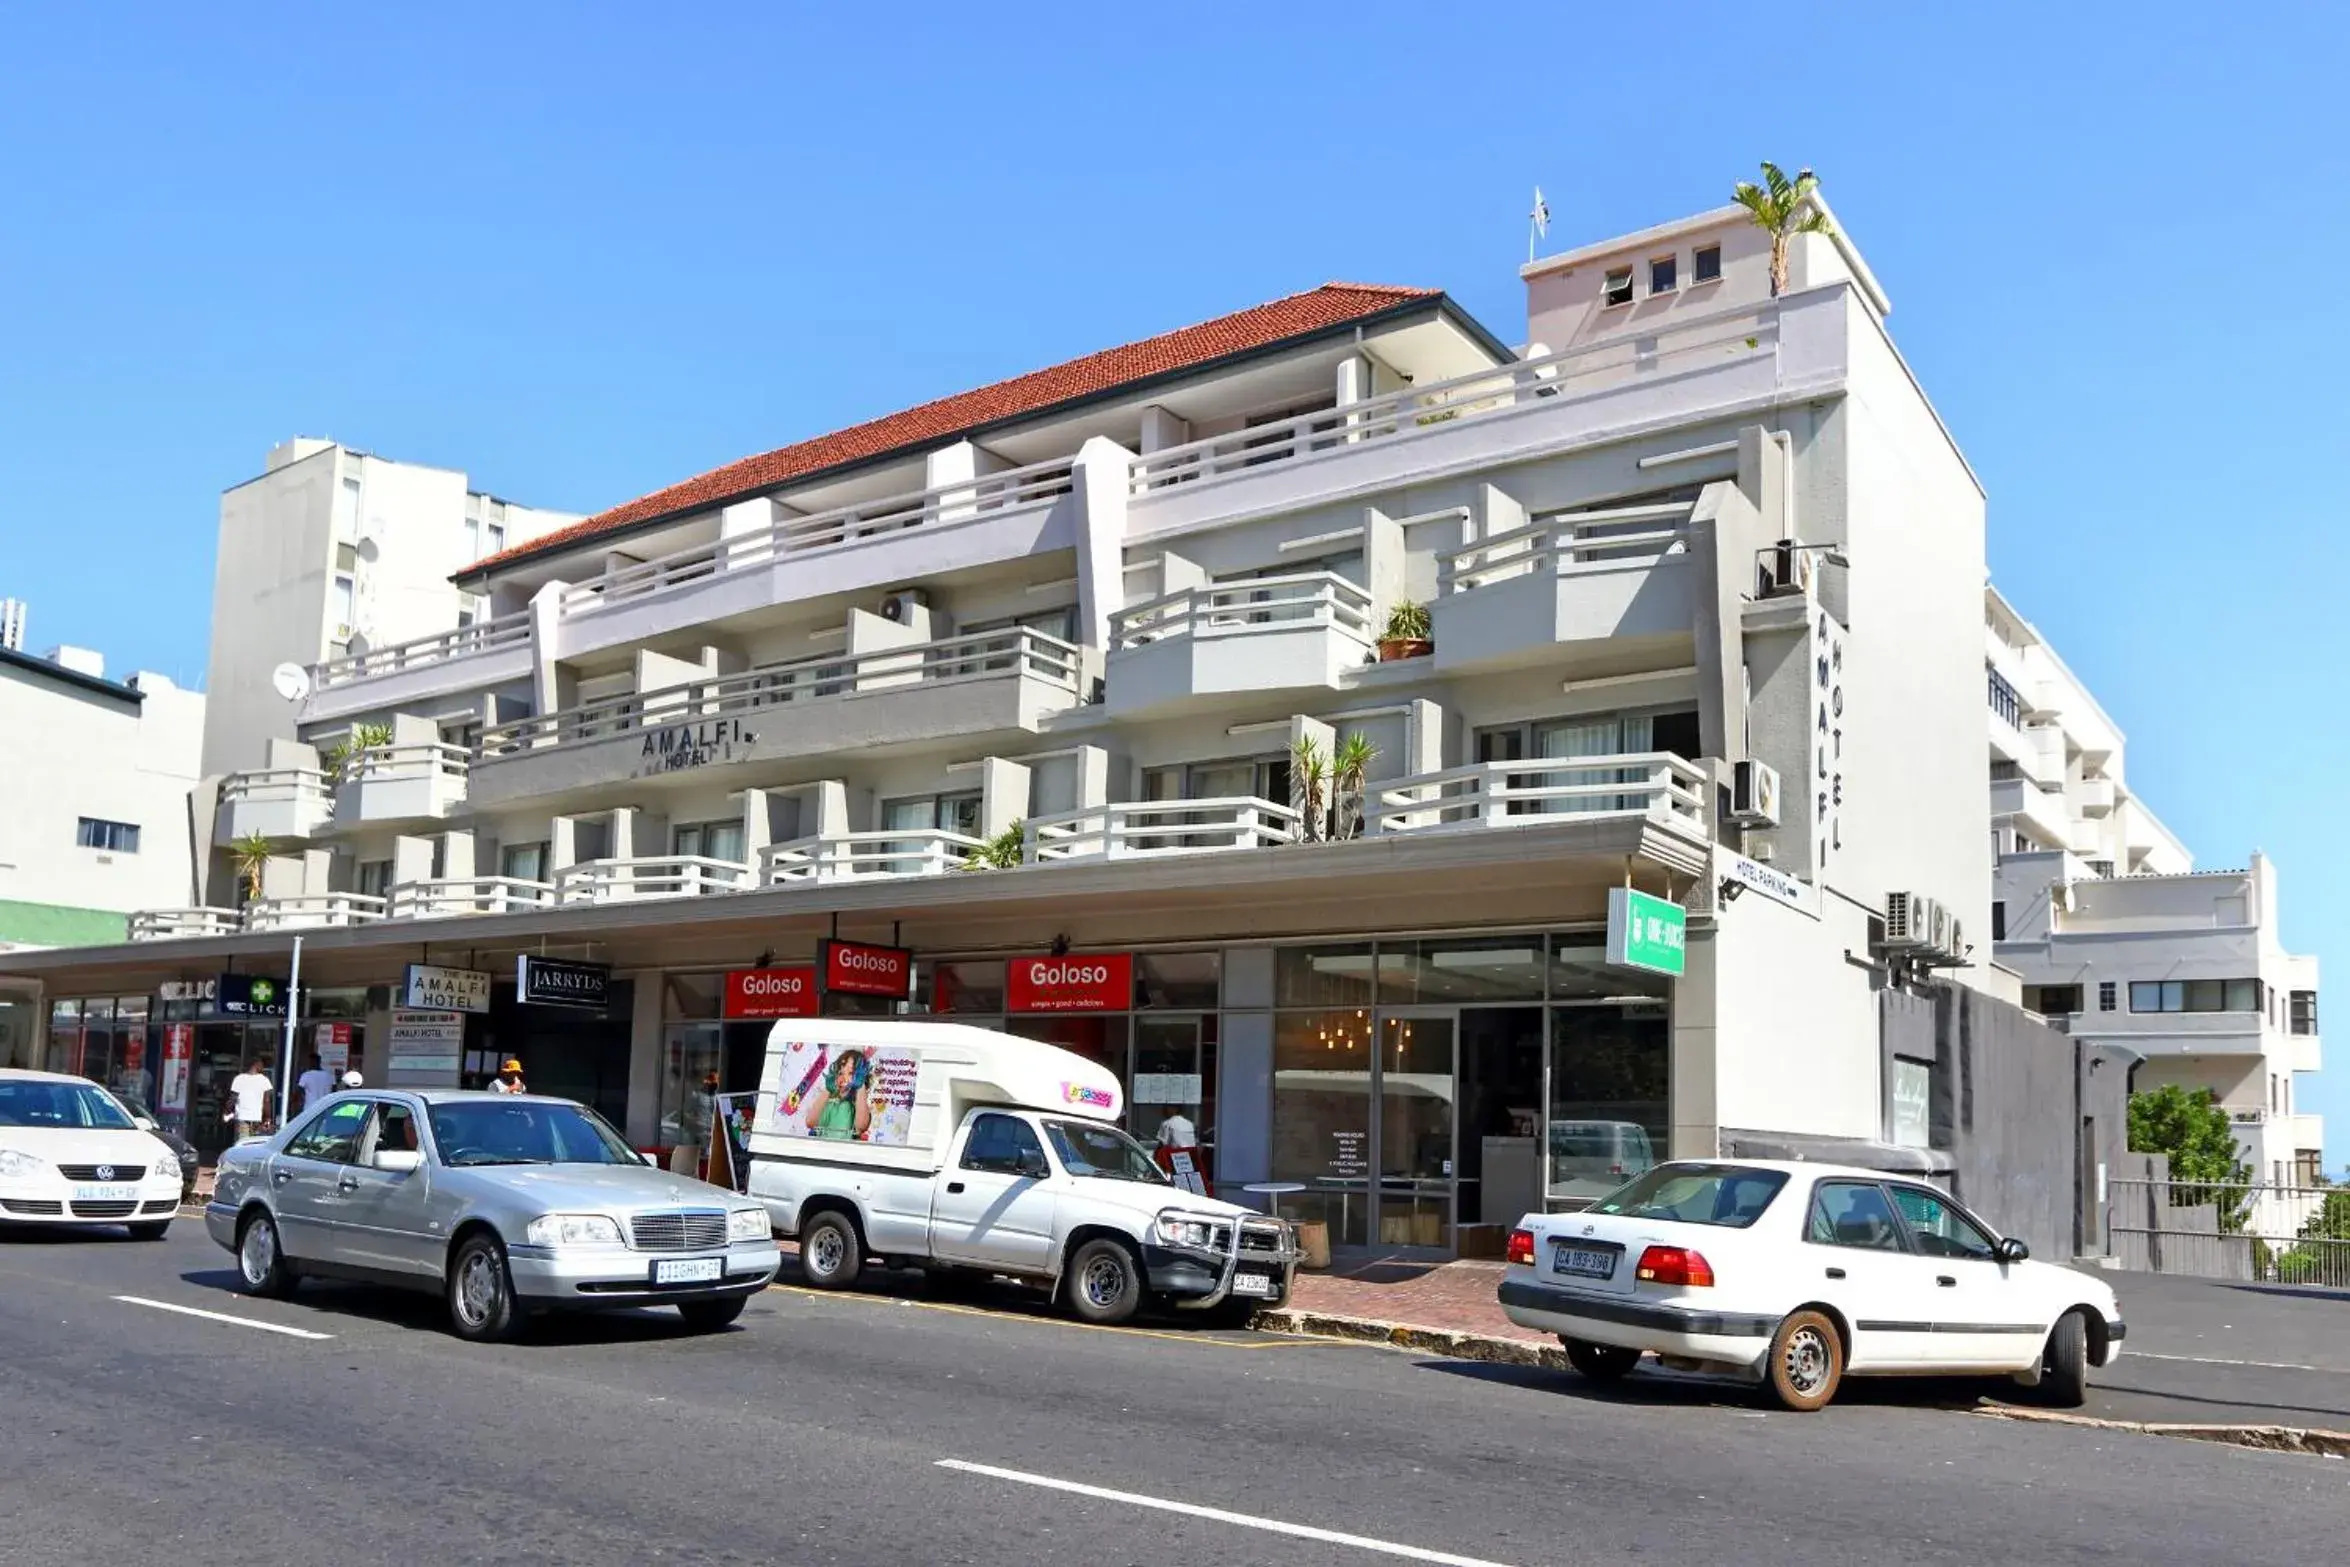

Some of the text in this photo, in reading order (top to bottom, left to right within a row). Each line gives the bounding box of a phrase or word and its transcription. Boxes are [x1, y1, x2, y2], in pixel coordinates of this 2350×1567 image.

[642, 719, 740, 756] AMALFI
[1817, 612, 1829, 868] AMALFI
[1832, 639, 1843, 850] HOTEL
[665, 749, 707, 770] HOTEL
[1736, 859, 1788, 897] HOTEL PARKING
[839, 948, 898, 973] Goloso
[534, 970, 605, 991] JARRYDS
[743, 974, 802, 995] Goloso
[1030, 962, 1107, 985] Goloso
[415, 977, 486, 995] AMALFI
[424, 993, 474, 1009] HOTEL
